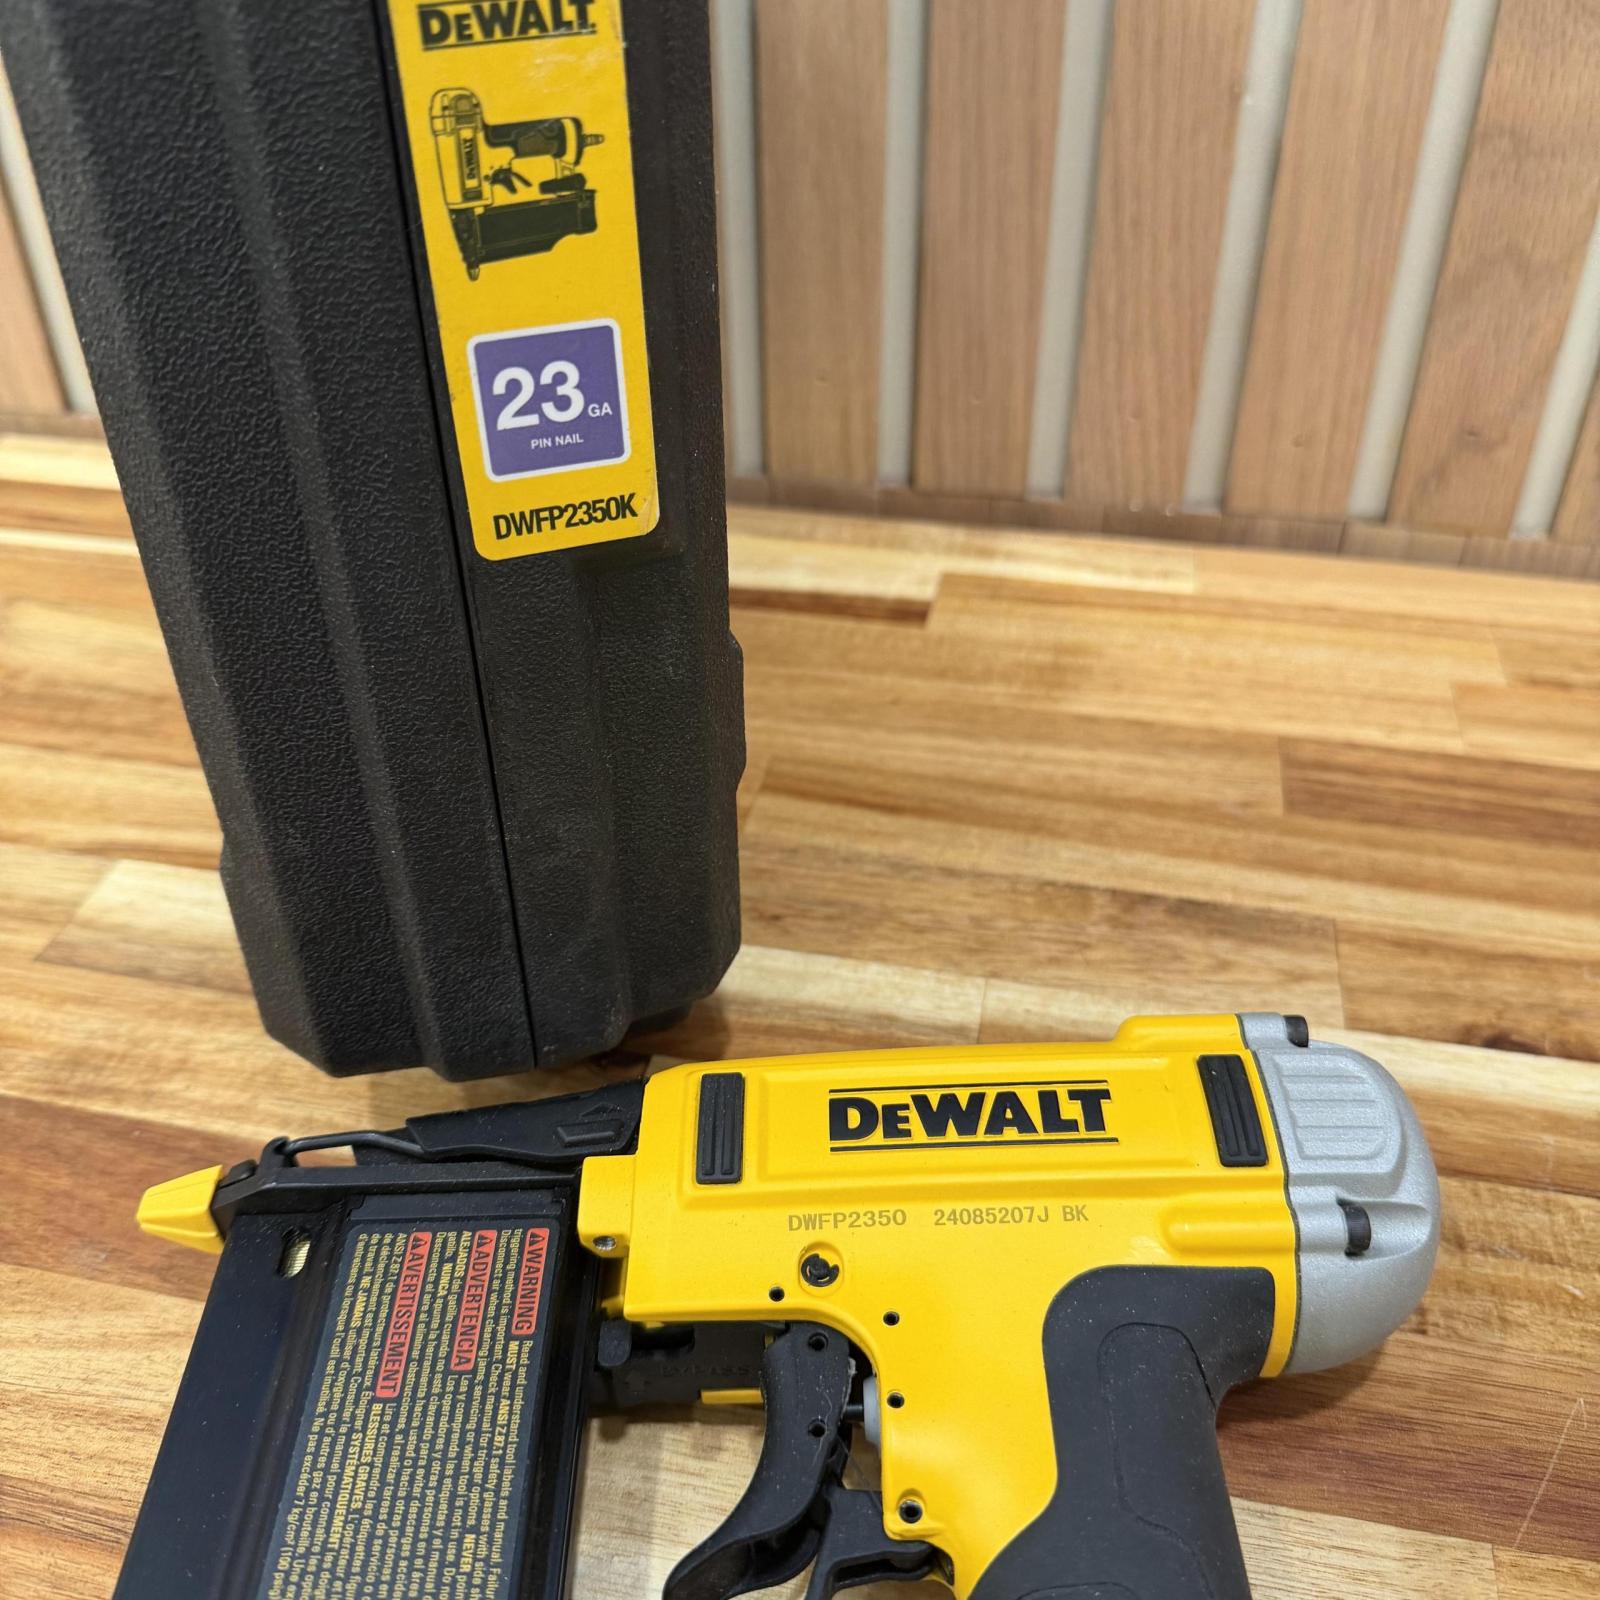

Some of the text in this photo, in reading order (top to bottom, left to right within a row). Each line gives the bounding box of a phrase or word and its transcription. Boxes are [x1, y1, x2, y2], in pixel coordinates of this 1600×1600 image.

[492, 360, 612, 431] 23 GA
[530, 433, 584, 449] PIN NAIL
[492, 492, 638, 540] DWFP2350K
[788, 1204, 1089, 1231] DWFP2350 24085207J BK
[370, 1233, 381, 1244] de
[383, 1233, 394, 1244] de
[394, 1233, 407, 1255] ANSI
[506, 1228, 523, 1270] triggering
[427, 1232, 447, 1282] Desconecte
[454, 1231, 472, 1277] ALEJADOS
[344, 1285, 354, 1296] ou
[359, 1276, 372, 1289] NE
[384, 1282, 395, 1293] de
[425, 1283, 435, 1292] el
[437, 1263, 453, 1297] NUNCA
[451, 1279, 462, 1292] del
[502, 1271, 515, 1304] method
[514, 1247, 543, 1331] WARNING
[336, 1298, 354, 1331] lorsque
[350, 1290, 368, 1328] JAMAIS
[421, 1293, 432, 1311] aire
[430, 1298, 444, 1329] apunte
[454, 1249, 491, 1367] ADVERTENCIA
[501, 1306, 509, 1314] is
[363, 1312, 374, 1327] est
[372, 1295, 391, 1346] protecteurs
[378, 1251, 426, 1394] AVERTISSEMENT
[419, 1312, 429, 1321] al
[343, 1329, 357, 1360] utiliser
[412, 1323, 427, 1360] eliminar
[428, 1330, 440, 1340] la
[438, 1323, 452, 1358] cuando
[325, 1360, 336, 1374] est
[417, 1341, 437, 1398] herramienta
[436, 1359, 445, 1371] no
[488, 1364, 502, 1393] Check
[446, 1375, 458, 1392] Los
[459, 1375, 472, 1392] Lea
[342, 1376, 362, 1422] Consulter
[383, 1403, 397, 1421] Lire
[442, 1229, 511, 1583] Disconnect air when clearing servicing or when tool is not in use. Do
[312, 1418, 325, 1432] Ne
[327, 1412, 337, 1425] ou
[411, 1400, 426, 1427] hacia
[423, 1396, 440, 1440] clavando
[435, 1394, 453, 1450] operadores
[482, 1395, 495, 1431] manual
[339, 1424, 351, 1433] le
[360, 1403, 383, 1463] BLESSURES
[380, 1423, 390, 1434] et
[394, 1434, 405, 1443] al
[448, 1402, 465, 1458] comprenda
[479, 1433, 491, 1447] for
[306, 1434, 318, 1453] pas
[330, 1435, 346, 1472] manuel
[405, 1429, 418, 1457] usted
[418, 1443, 430, 1466] para
[490, 1340, 533, 1565] Read and understand tool labels and manual.
[367, 1436, 387, 1498] comprendre
[386, 1446, 401, 1484] realizar
[428, 1460, 441, 1487] otras
[445, 1460, 458, 1476] las
[472, 1341, 519, 1585] MUST wear ANSI safety glasses with side
[472, 1449, 488, 1484] trigger
[312, 1471, 323, 1489] gaz
[324, 1475, 337, 1499] pour
[327, 1433, 363, 1550] SYSTÉMATIQUEMENT
[350, 1466, 370, 1511] GRAVES.
[397, 1468, 413, 1497] hacia
[412, 1468, 426, 1498] evitar
[308, 1491, 319, 1504] en
[363, 1500, 377, 1516] les
[378, 1486, 394, 1520] tareas
[436, 1478, 453, 1527] etiquetas
[466, 1486, 480, 1528] options.
[391, 1500, 405, 1527] otras
[419, 1489, 436, 1539] personas
[375, 1522, 388, 1536] de
[400, 1500, 421, 1557] descargas
[381, 1530, 399, 1581] personas
[416, 1541, 426, 1555] en
[432, 1538, 443, 1549] el
[459, 1534, 476, 1572] NEVER
[289, 1559, 305, 1582] Une
[307, 1555, 321, 1572] les
[322, 1552, 337, 1568] les
[366, 1539, 383, 1583] servicio
[414, 1558, 425, 1568] el
[424, 1551, 439, 1592] manual
[332, 1580, 343, 1592] et
[363, 1585, 373, 1593] o
[377, 1584, 389, 1598] en
[408, 1571, 424, 1597] área
